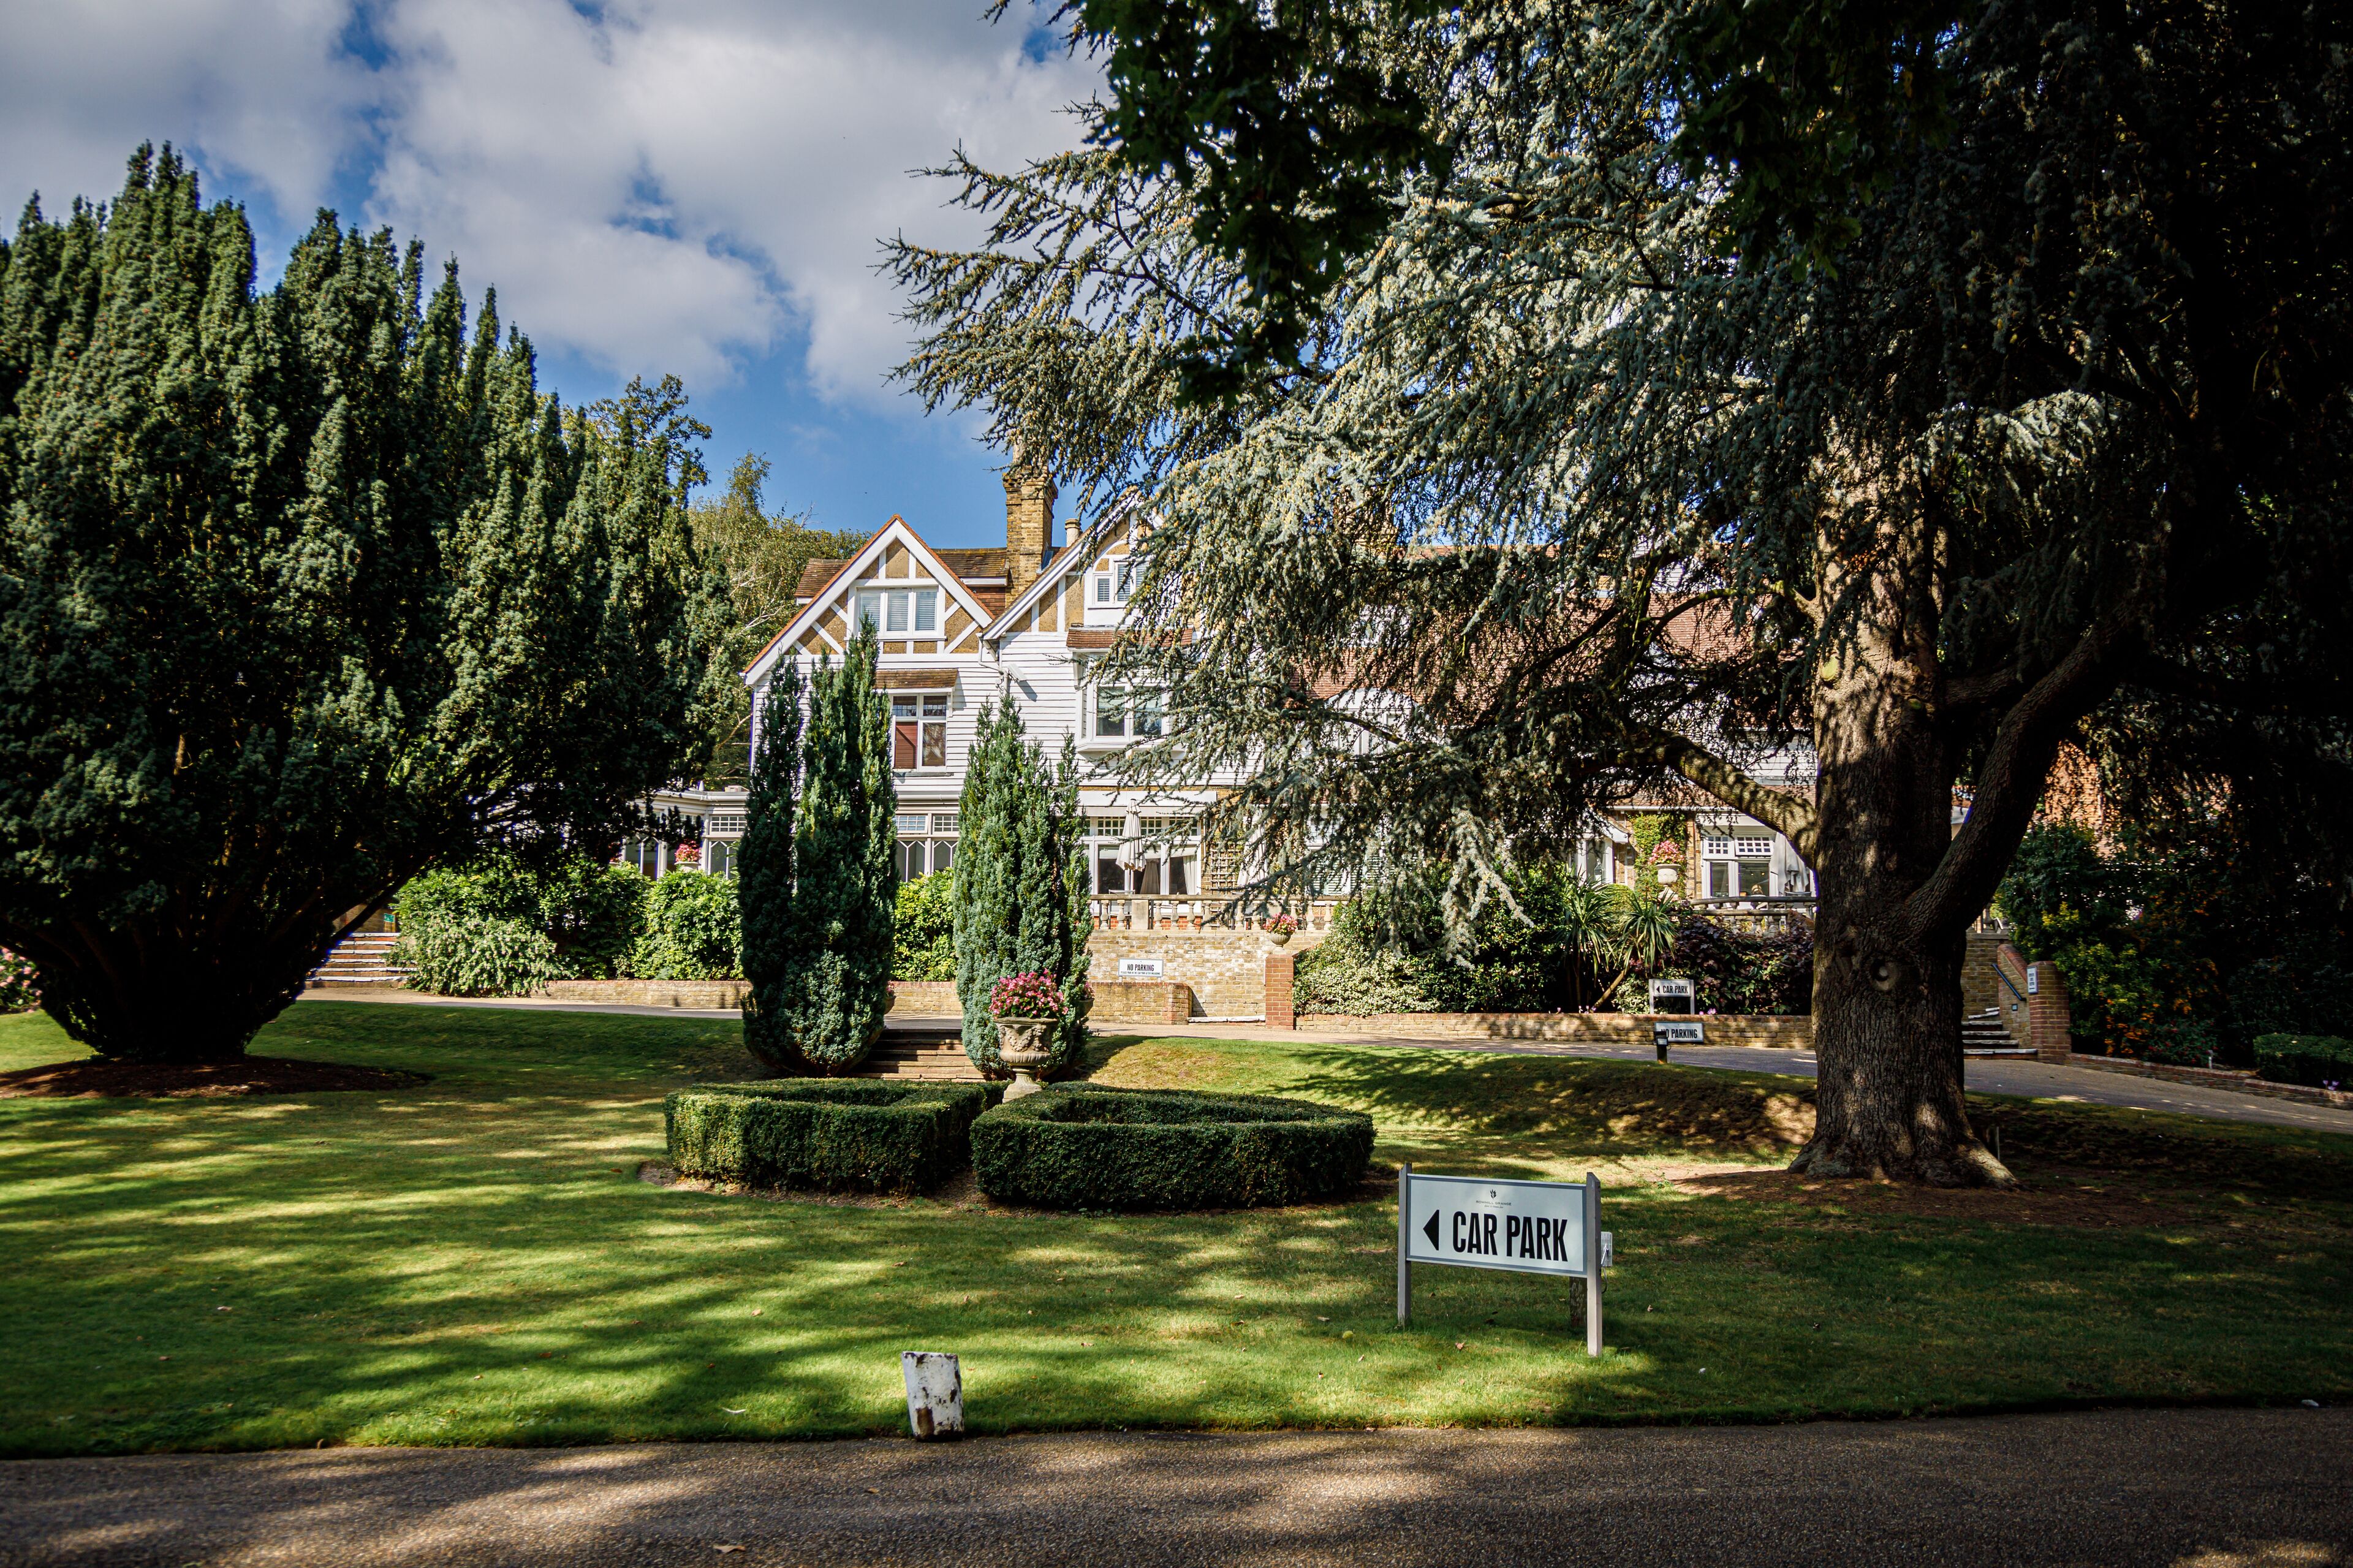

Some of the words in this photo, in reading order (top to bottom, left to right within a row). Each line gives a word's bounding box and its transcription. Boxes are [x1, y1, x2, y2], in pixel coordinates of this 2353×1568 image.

[1661, 1029, 1669, 1038] O
[1671, 1029, 1697, 1039] PARKING
[1453, 1211, 1498, 1256] CAR
[1507, 1215, 1568, 1262] PARK
